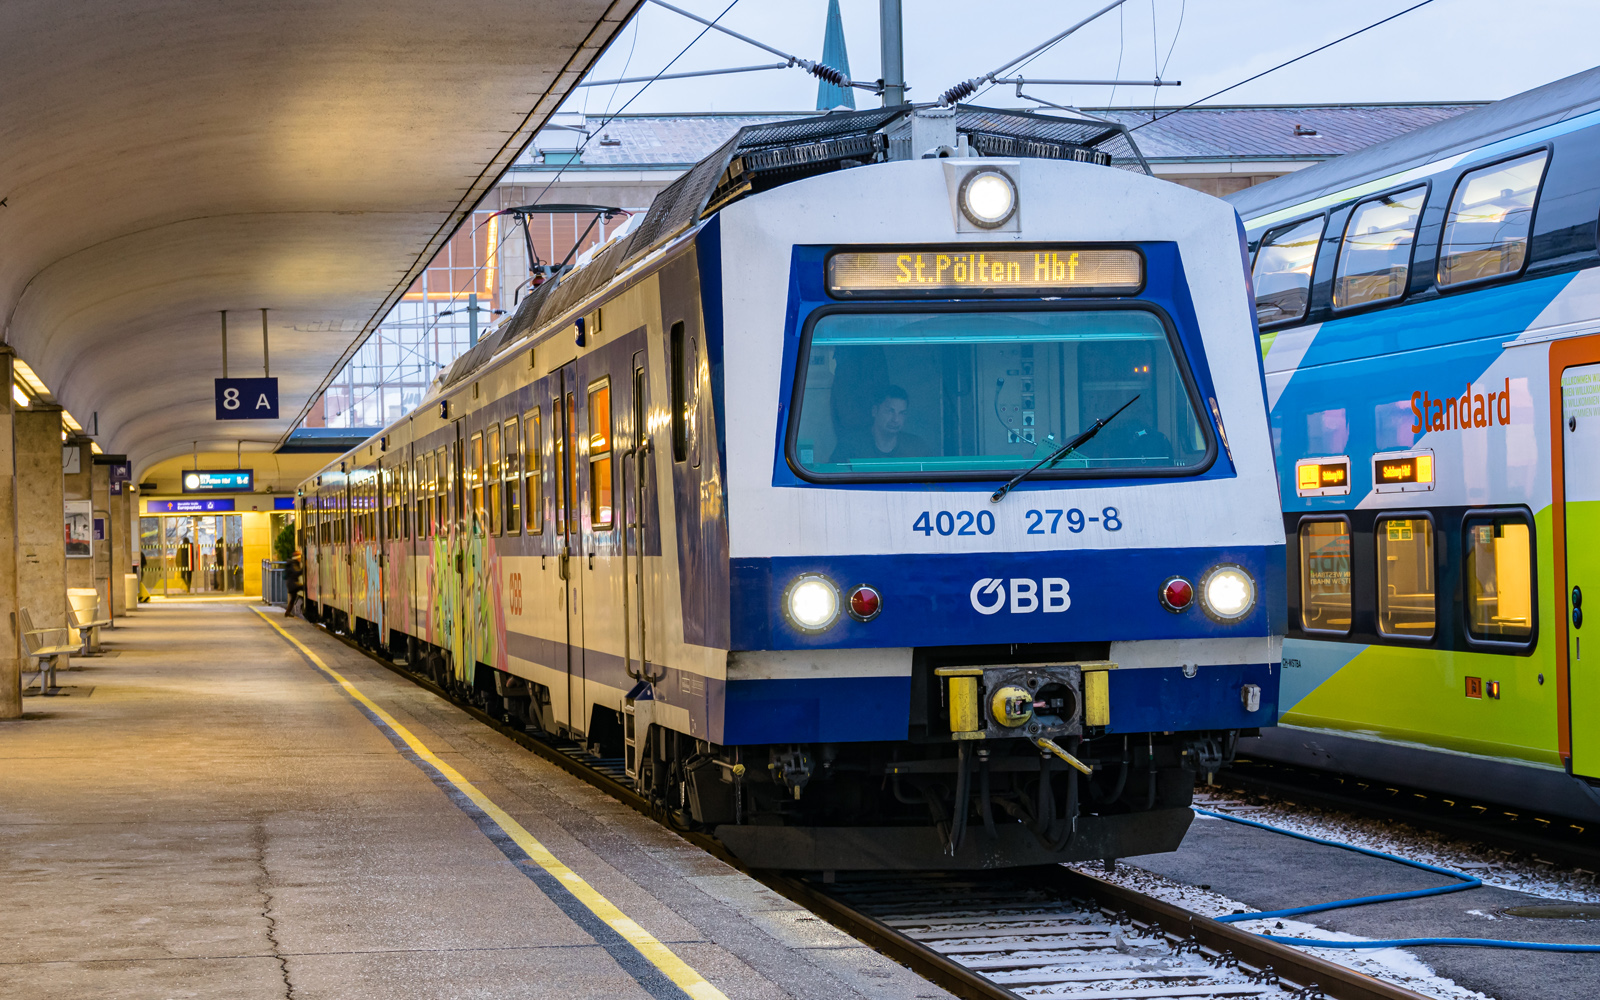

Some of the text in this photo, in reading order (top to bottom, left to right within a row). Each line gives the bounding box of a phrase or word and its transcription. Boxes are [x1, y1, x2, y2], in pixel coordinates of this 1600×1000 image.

[1034, 252, 1079, 282] Hbf
[222, 387, 271, 410] 8 A
[1411, 377, 1511, 434] Standard
[912, 506, 1123, 536] 4020 279-8
[970, 577, 1072, 615] ÖBB
